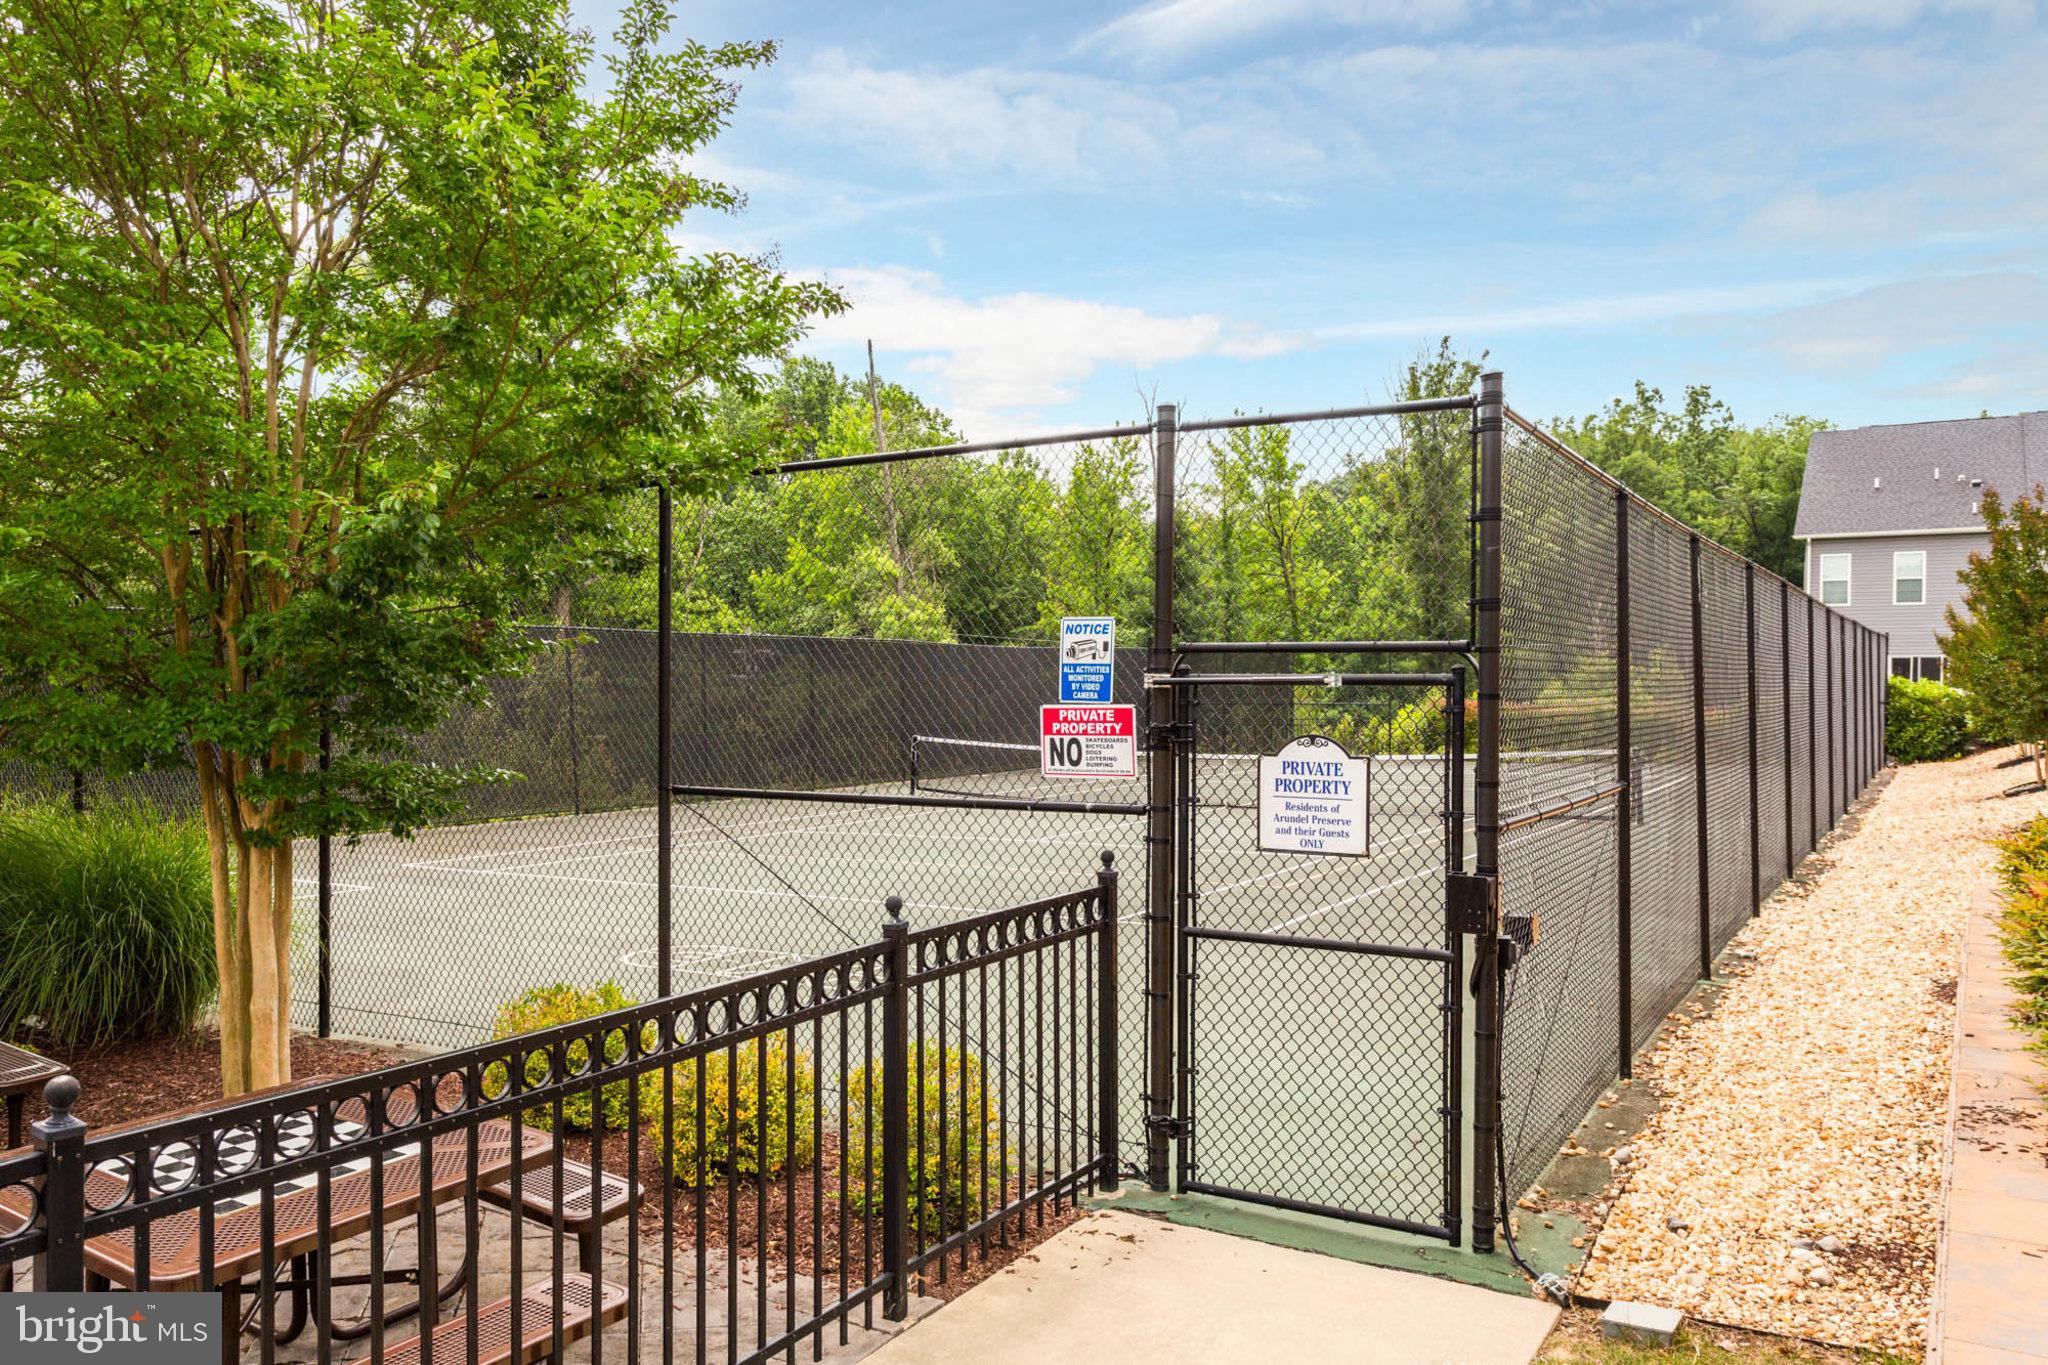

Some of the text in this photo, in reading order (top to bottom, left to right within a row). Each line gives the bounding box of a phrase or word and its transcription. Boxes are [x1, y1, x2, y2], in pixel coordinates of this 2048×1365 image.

[1065, 624, 1110, 635] NOTICE
[1059, 710, 1114, 721] PRIVATE
[1053, 723, 1122, 734] PROPERTY
[1049, 737, 1082, 767] NO
[1282, 761, 1343, 776] PRIVATE
[1275, 778, 1351, 795] PROPERTY
[1285, 802, 1341, 813] Residents of
[1274, 814, 1352, 826] Arundel Preserve
[1276, 826, 1350, 838] and their Guests
[1300, 839, 1324, 849] ONLY
